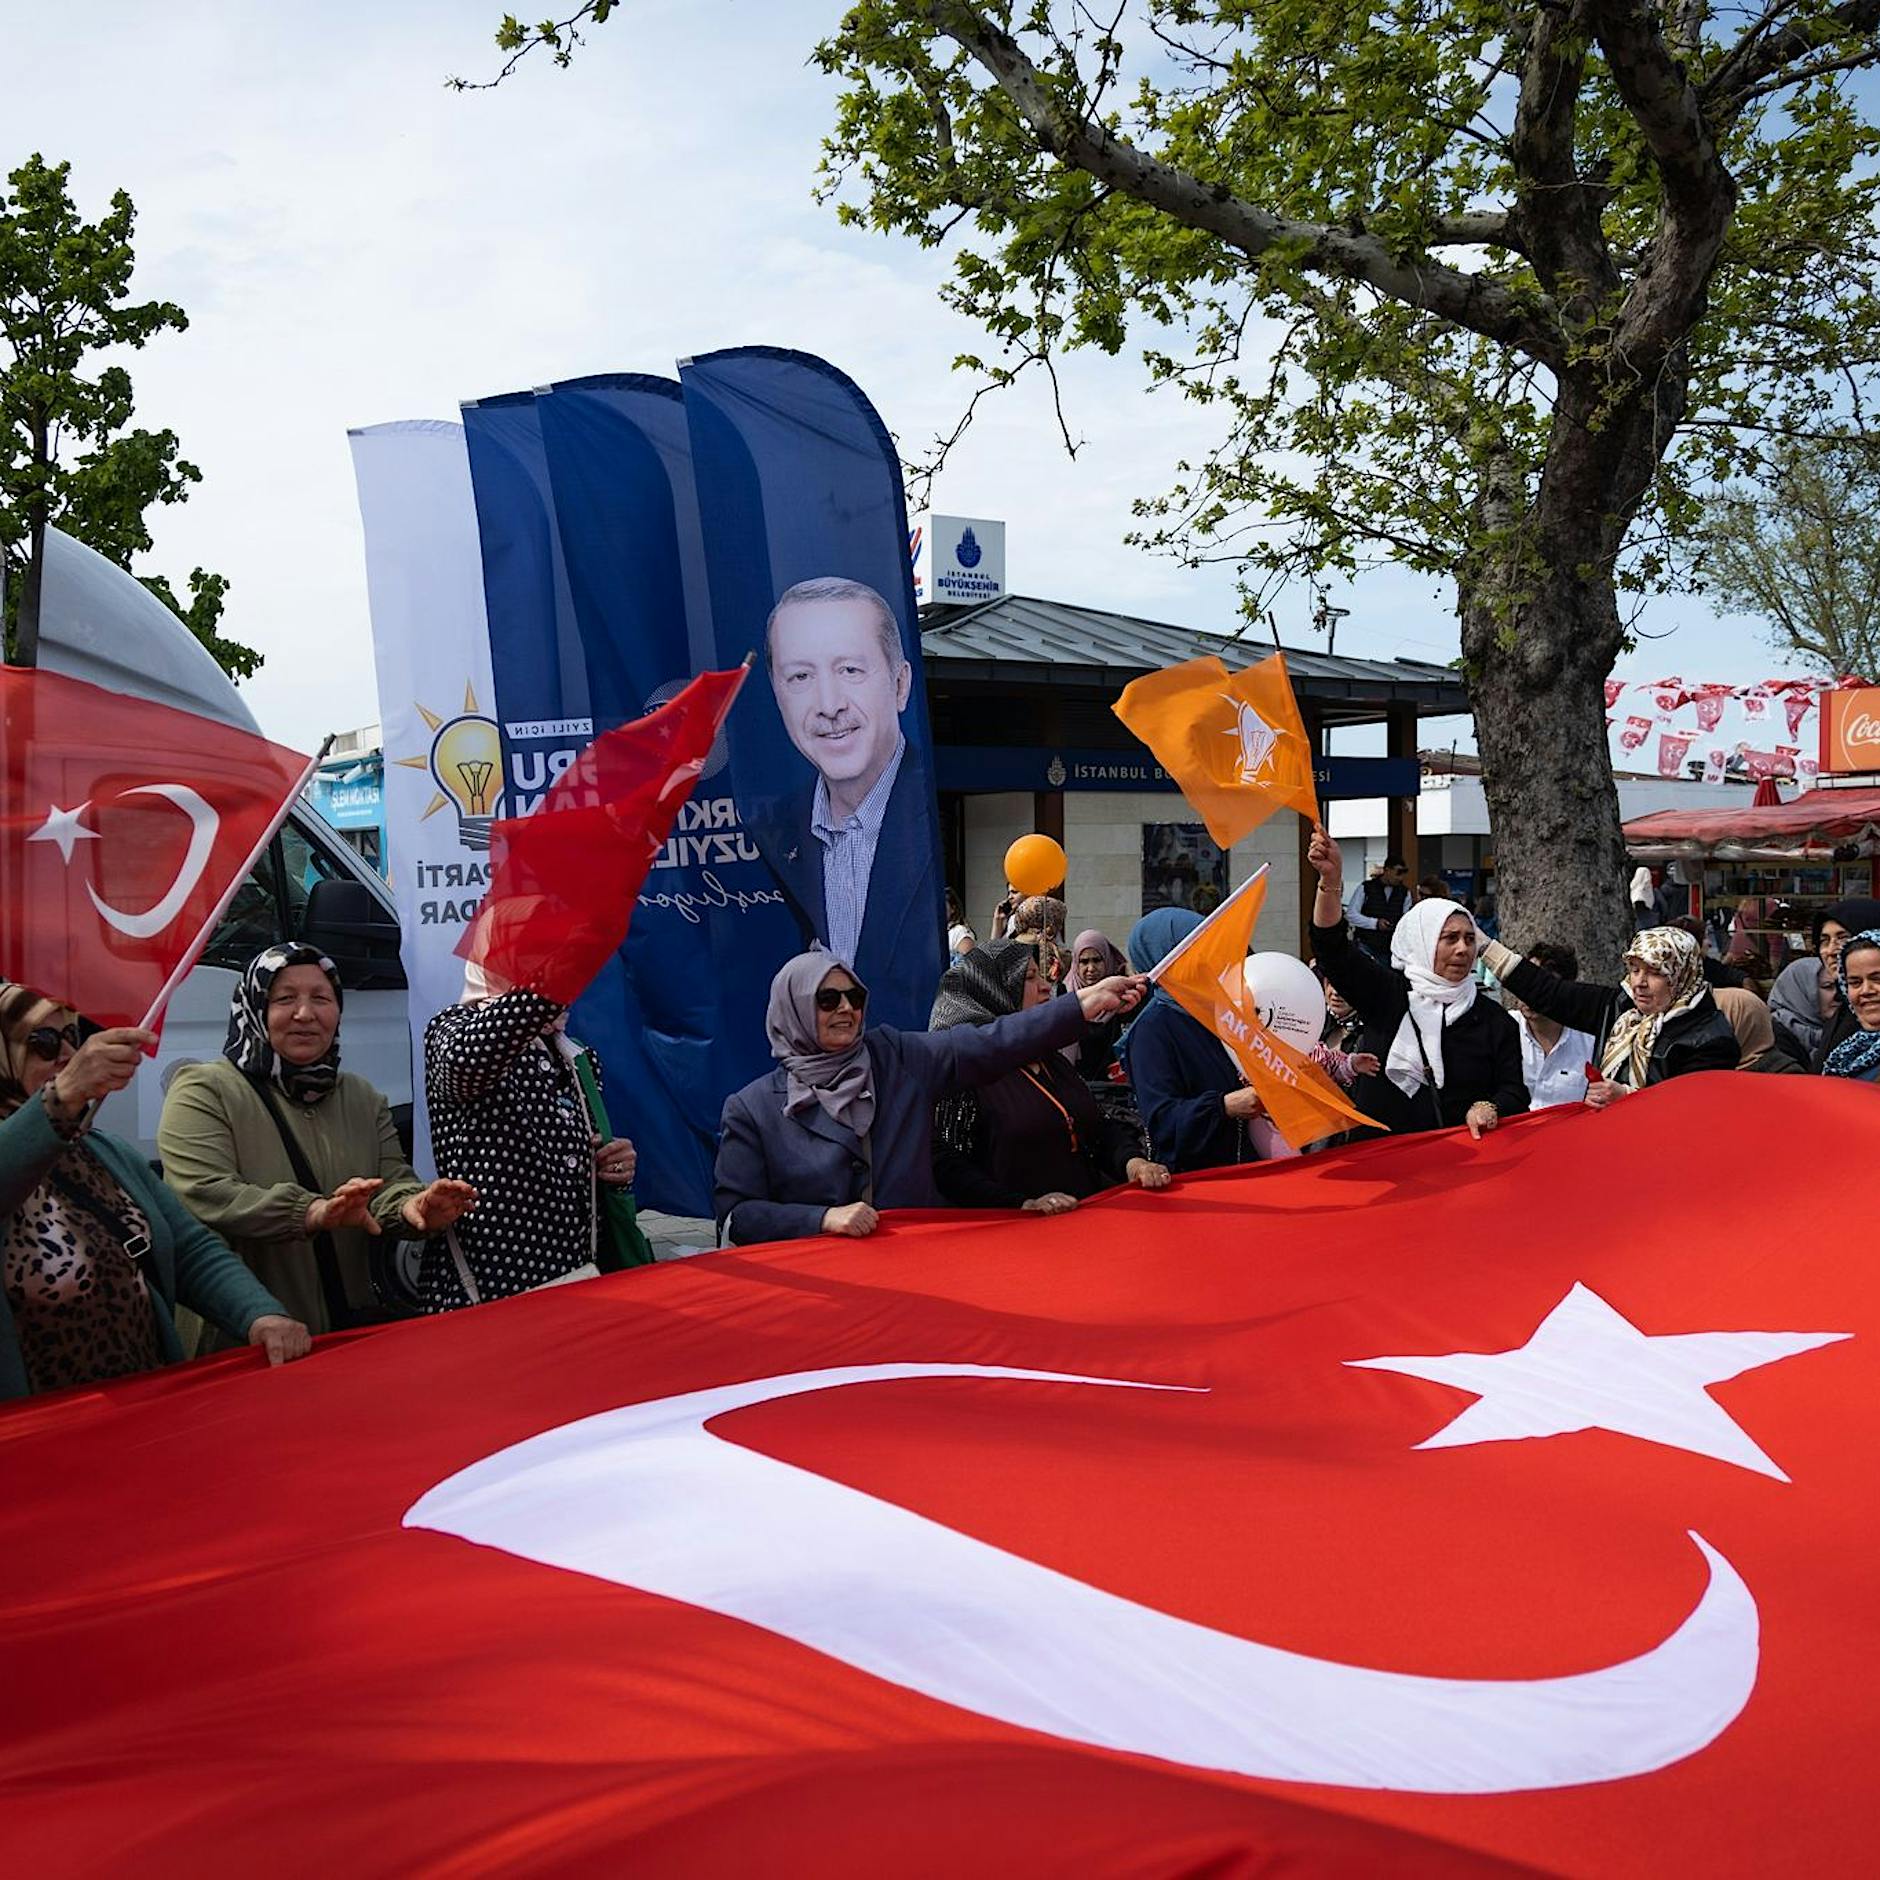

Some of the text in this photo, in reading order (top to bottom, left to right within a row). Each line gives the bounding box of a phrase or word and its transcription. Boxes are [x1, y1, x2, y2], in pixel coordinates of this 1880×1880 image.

[1074, 763, 1147, 779] İSTANBUL
[1219, 1009, 1249, 1043] AK
[1249, 1034, 1298, 1087] PARTİ
